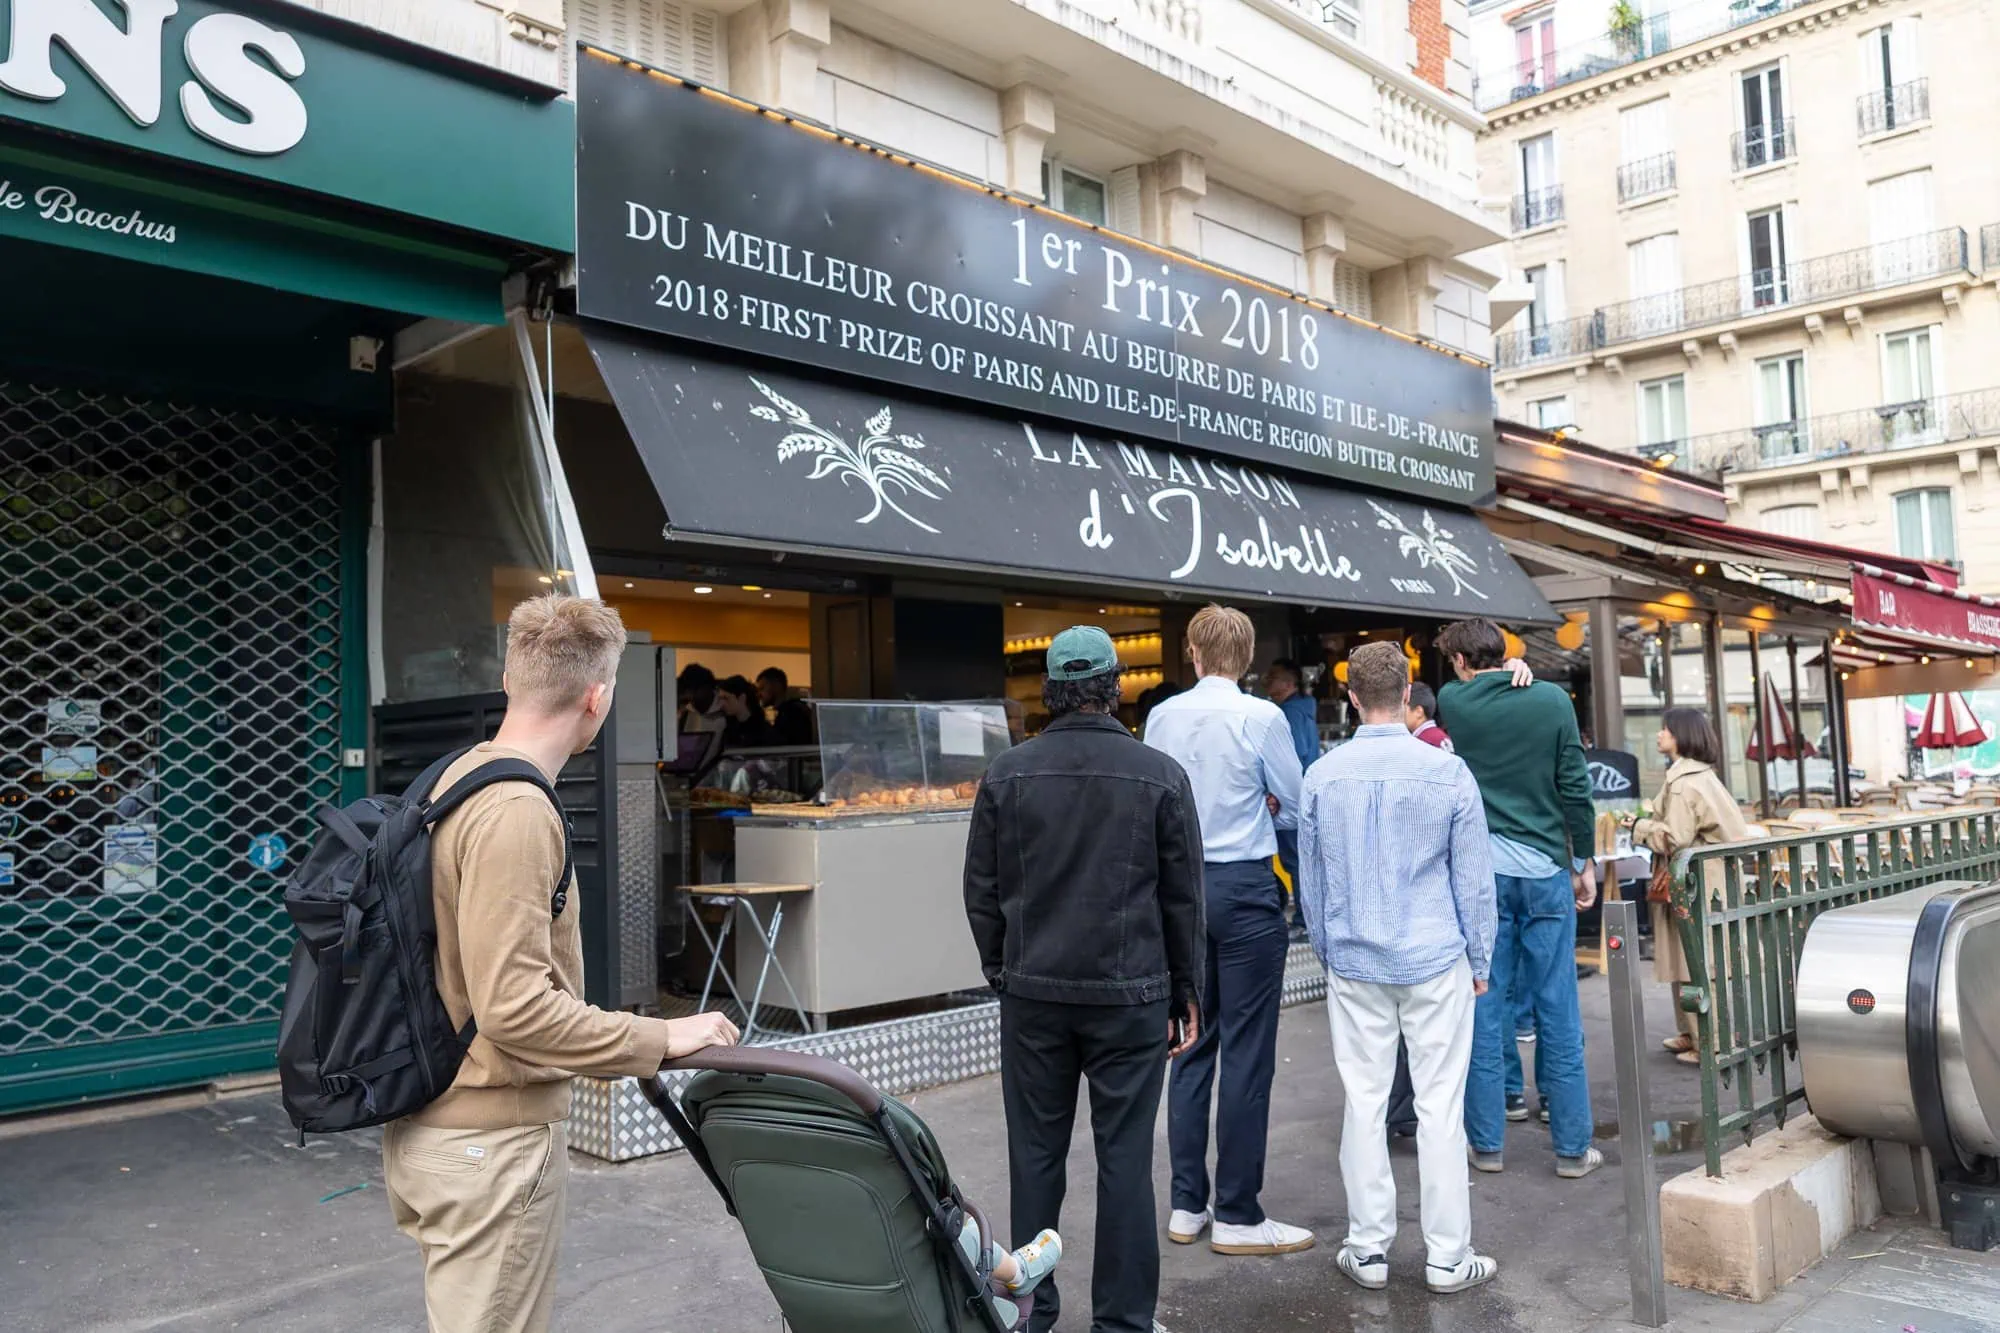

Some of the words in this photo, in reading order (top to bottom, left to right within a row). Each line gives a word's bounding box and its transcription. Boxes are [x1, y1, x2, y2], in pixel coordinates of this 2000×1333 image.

[34, 186, 176, 243] Bacchus
[625, 200, 690, 250] DU
[703, 222, 897, 306] MEILLEUR
[906, 280, 1075, 350] CROISSANT
[1082, 329, 1119, 363] AU
[1126, 340, 1221, 391] BEURRE
[1226, 368, 1256, 399] DE
[1261, 377, 1317, 416] PARIS
[1322, 394, 1344, 423] ET
[1350, 402, 1480, 459] ILE-DE-FRANCE
[1012, 218, 1082, 287] 1er
[1101, 246, 1204, 338] Prix
[1220, 287, 1320, 371] 2018
[654, 274, 729, 320] 2018
[739, 294, 832, 344] FIRST
[839, 318, 924, 365] PRIZE
[931, 342, 965, 373] OF
[972, 352, 1044, 392] PARIS
[1049, 371, 1100, 404] AND
[1105, 383, 1263, 443] ILE-DE-FRANCE
[1269, 423, 1333, 459] REGION
[1337, 440, 1397, 475] BUTTER
[1400, 456, 1476, 492] CROISSANT
[1018, 421, 1101, 469] LA
[1114, 440, 1301, 510] MAISON
[1390, 577, 1436, 594] PARIS
[1879, 589, 1897, 616] BAR
